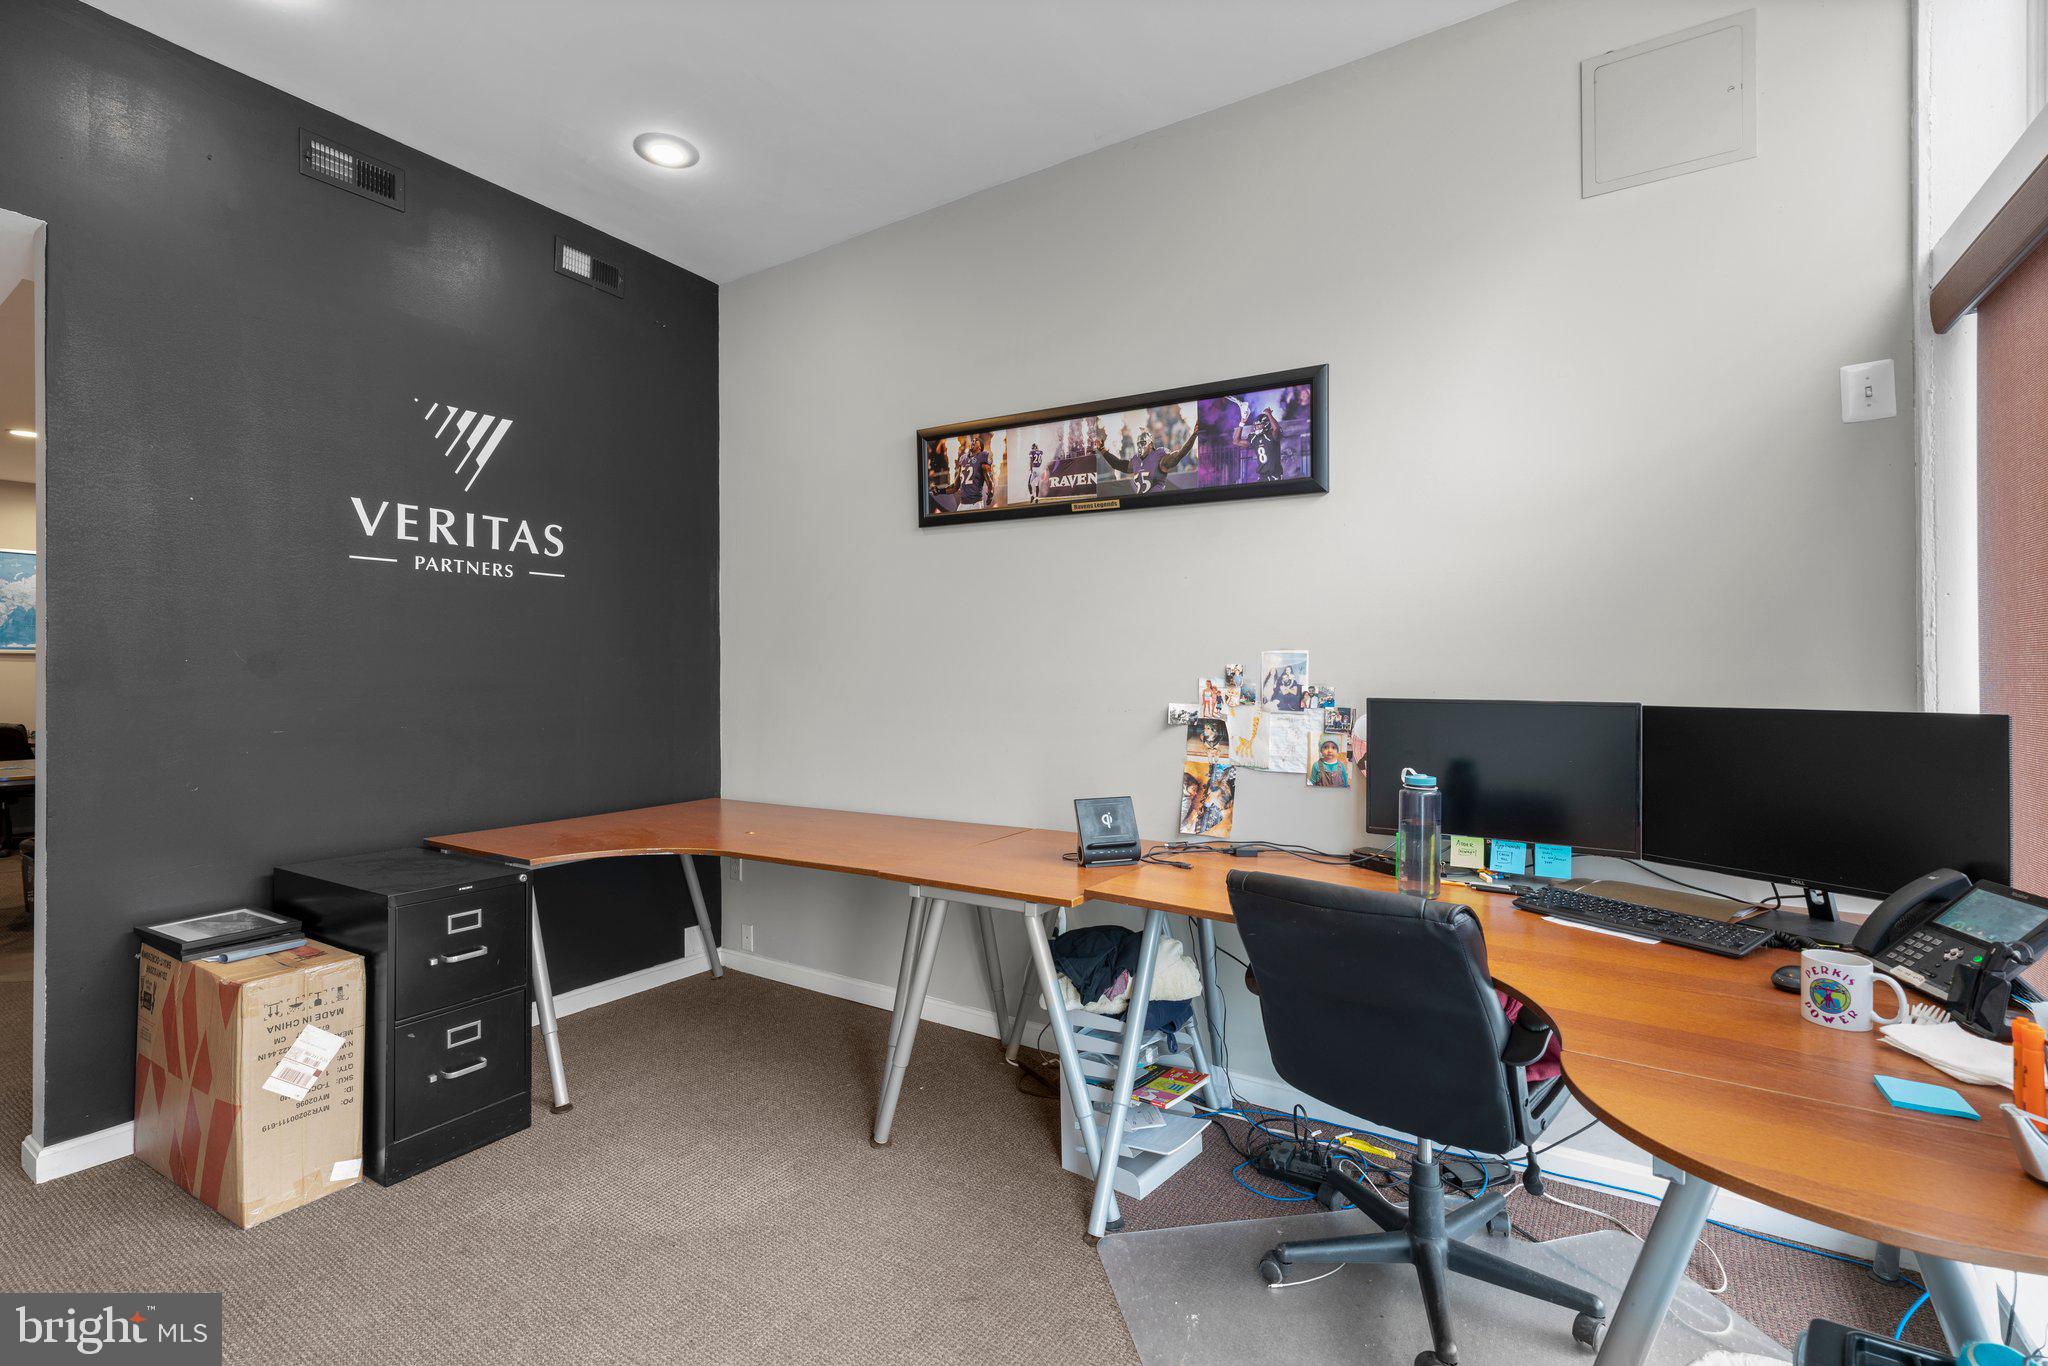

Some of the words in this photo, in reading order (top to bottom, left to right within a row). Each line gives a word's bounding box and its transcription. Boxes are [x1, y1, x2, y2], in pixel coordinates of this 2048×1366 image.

[1257, 446, 1268, 464] 8
[1094, 501, 1118, 509] Legends
[350, 496, 564, 557] VERITAS
[414, 555, 514, 578] PARTNERS
[1805, 965, 1855, 986] PERKIS
[315, 1007, 345, 1021] MADE
[1805, 1001, 1858, 1024] POWER
[266, 1019, 300, 1034] CHINA
[302, 1016, 312, 1026] IN
[334, 1029, 354, 1038] MEA
[273, 1036, 287, 1045] CM
[337, 1063, 354, 1073] QTY:
[336, 1074, 354, 1084] SKU:
[340, 1097, 354, 1105] PO:
